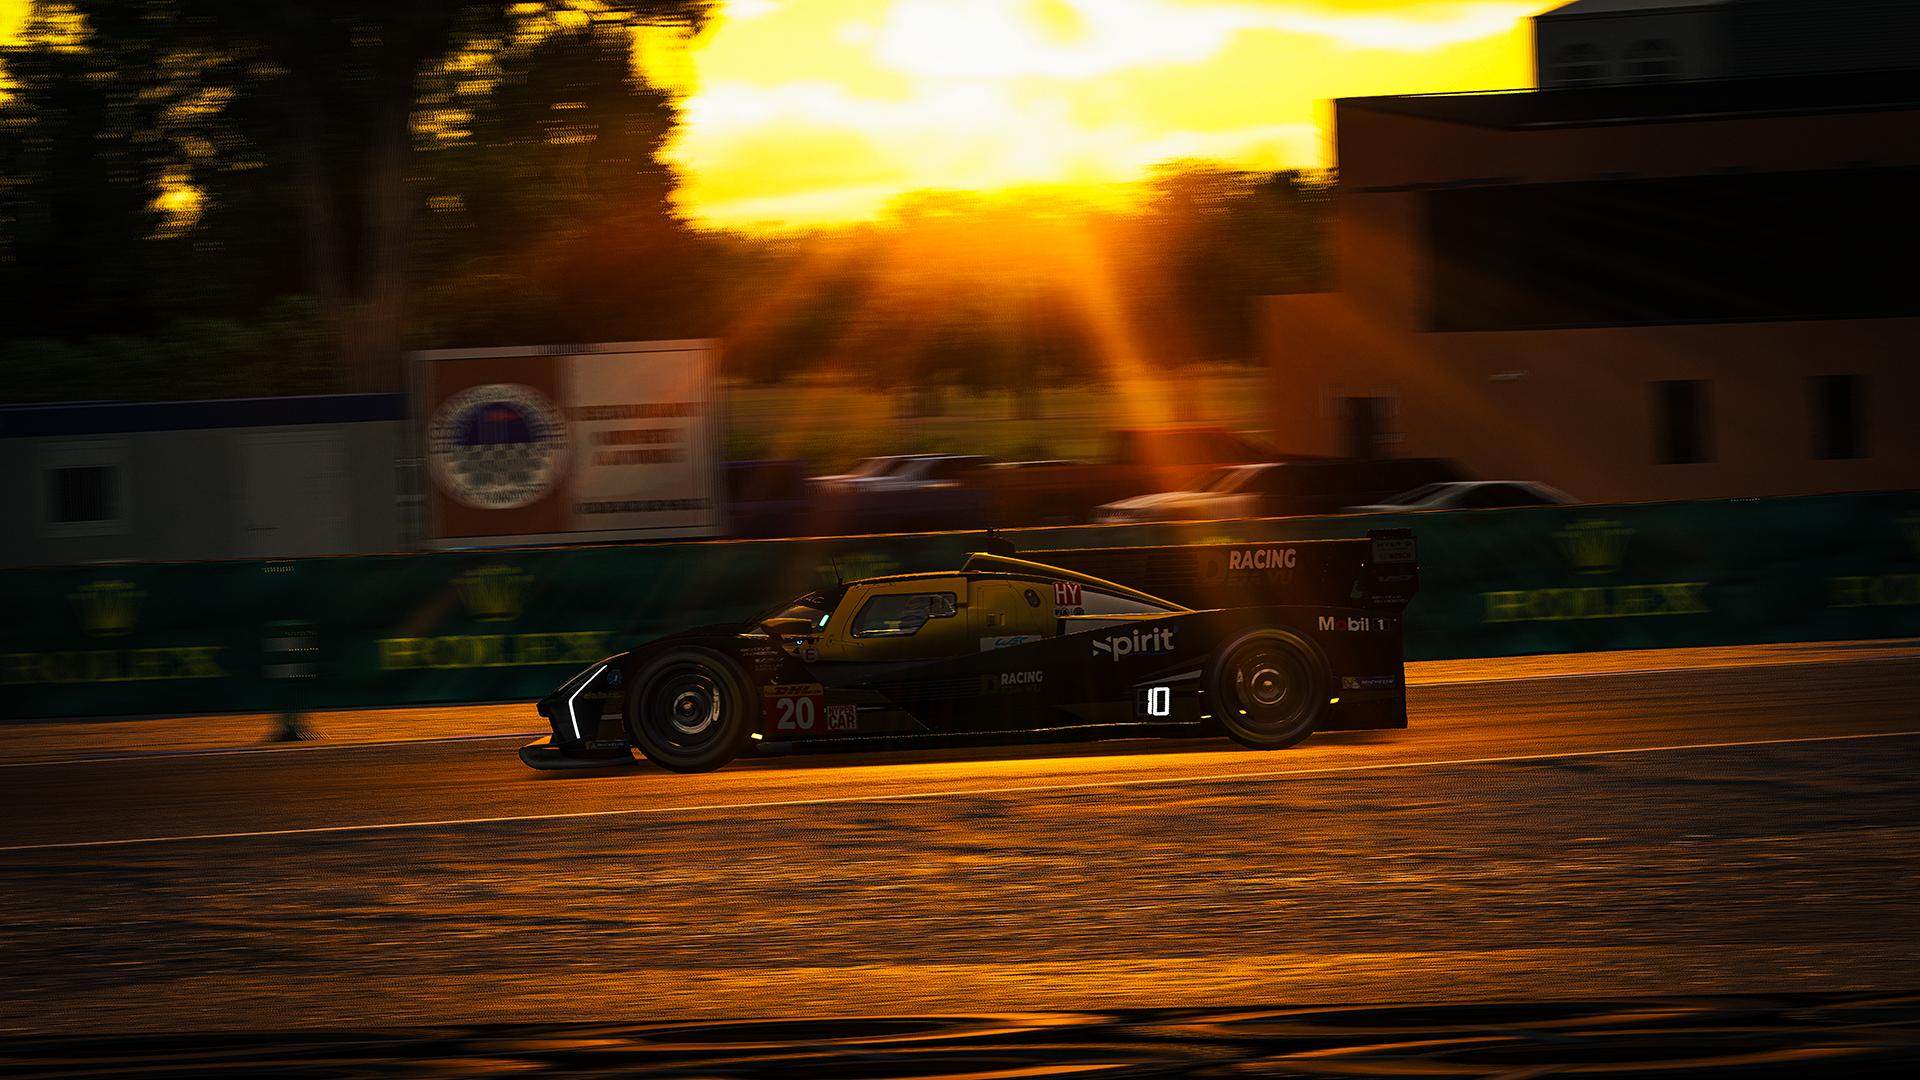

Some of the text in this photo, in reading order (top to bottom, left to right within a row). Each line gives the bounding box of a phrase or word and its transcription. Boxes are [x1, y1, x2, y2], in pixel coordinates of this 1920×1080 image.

[1228, 548, 1297, 569] RACING
[1055, 583, 1078, 604] HY
[1480, 581, 1712, 623] ROLEX
[1318, 615, 1369, 632] Mobil
[378, 631, 616, 671] ROLEX
[1000, 670, 1043, 686] RACING
[776, 696, 816, 730] 20
[828, 714, 856, 729] CAR
